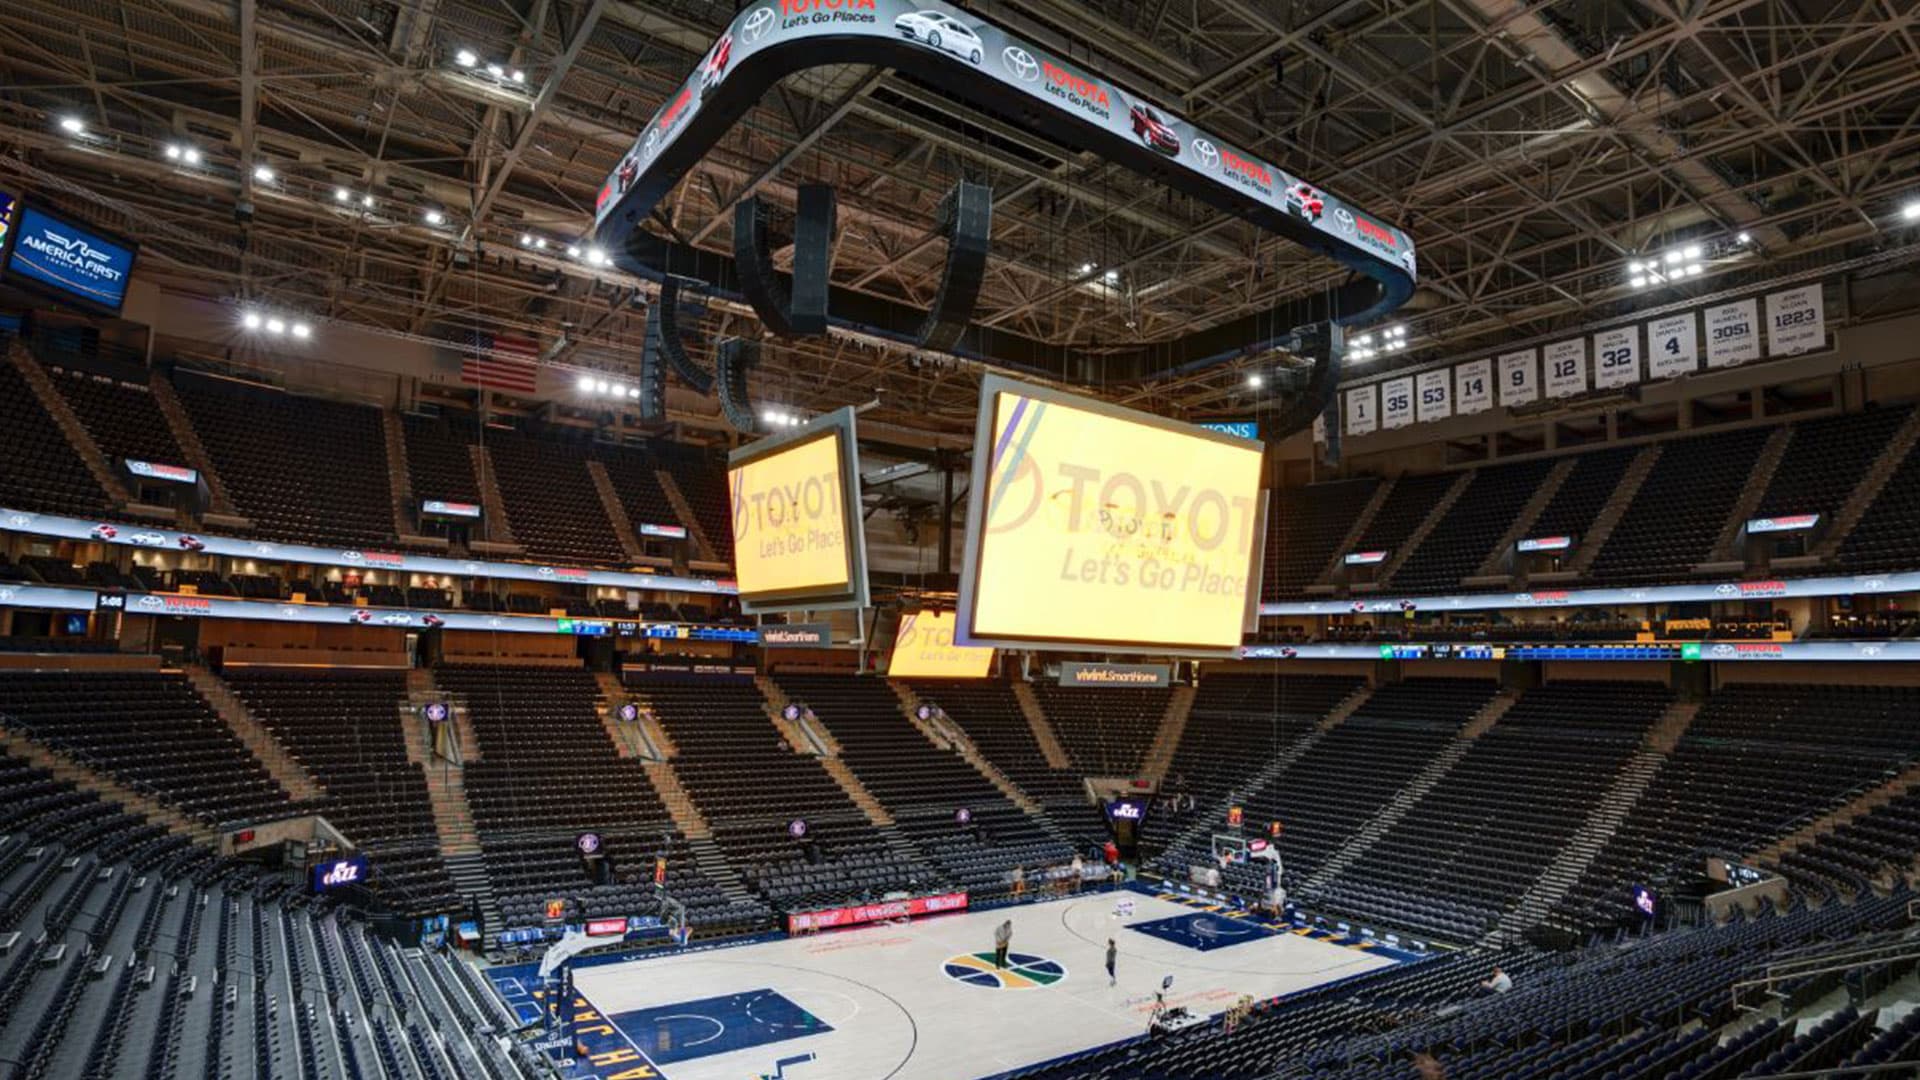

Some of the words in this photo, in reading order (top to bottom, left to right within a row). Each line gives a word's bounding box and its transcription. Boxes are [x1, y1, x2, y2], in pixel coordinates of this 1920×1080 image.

[782, 14, 809, 29] Let's
[812, 12, 830, 23] Go
[832, 11, 876, 23] Places
[1042, 60, 1110, 110] TOYOTA
[1045, 82, 1066, 98] Let's
[1068, 91, 1081, 105] Go
[1082, 99, 1110, 119] Places
[1222, 149, 1272, 187] TOYOTA
[1355, 215, 1397, 248] TOYOTA
[23, 235, 84, 268] AMERICA
[85, 260, 122, 281] FIRST
[1775, 308, 1816, 328] 1223
[1713, 322, 1750, 340] 3051
[1665, 337, 1680, 355] 4
[1602, 348, 1631, 368] 32
[1511, 370, 1524, 386] 9
[1554, 359, 1576, 378] 12
[1423, 387, 1445, 404] 53
[1464, 379, 1483, 396] 14
[1358, 404, 1365, 418] 1
[1387, 395, 1408, 412] 35
[788, 533, 804, 555] Go
[1060, 548, 1130, 585] Let's
[1139, 558, 1175, 591] Go
